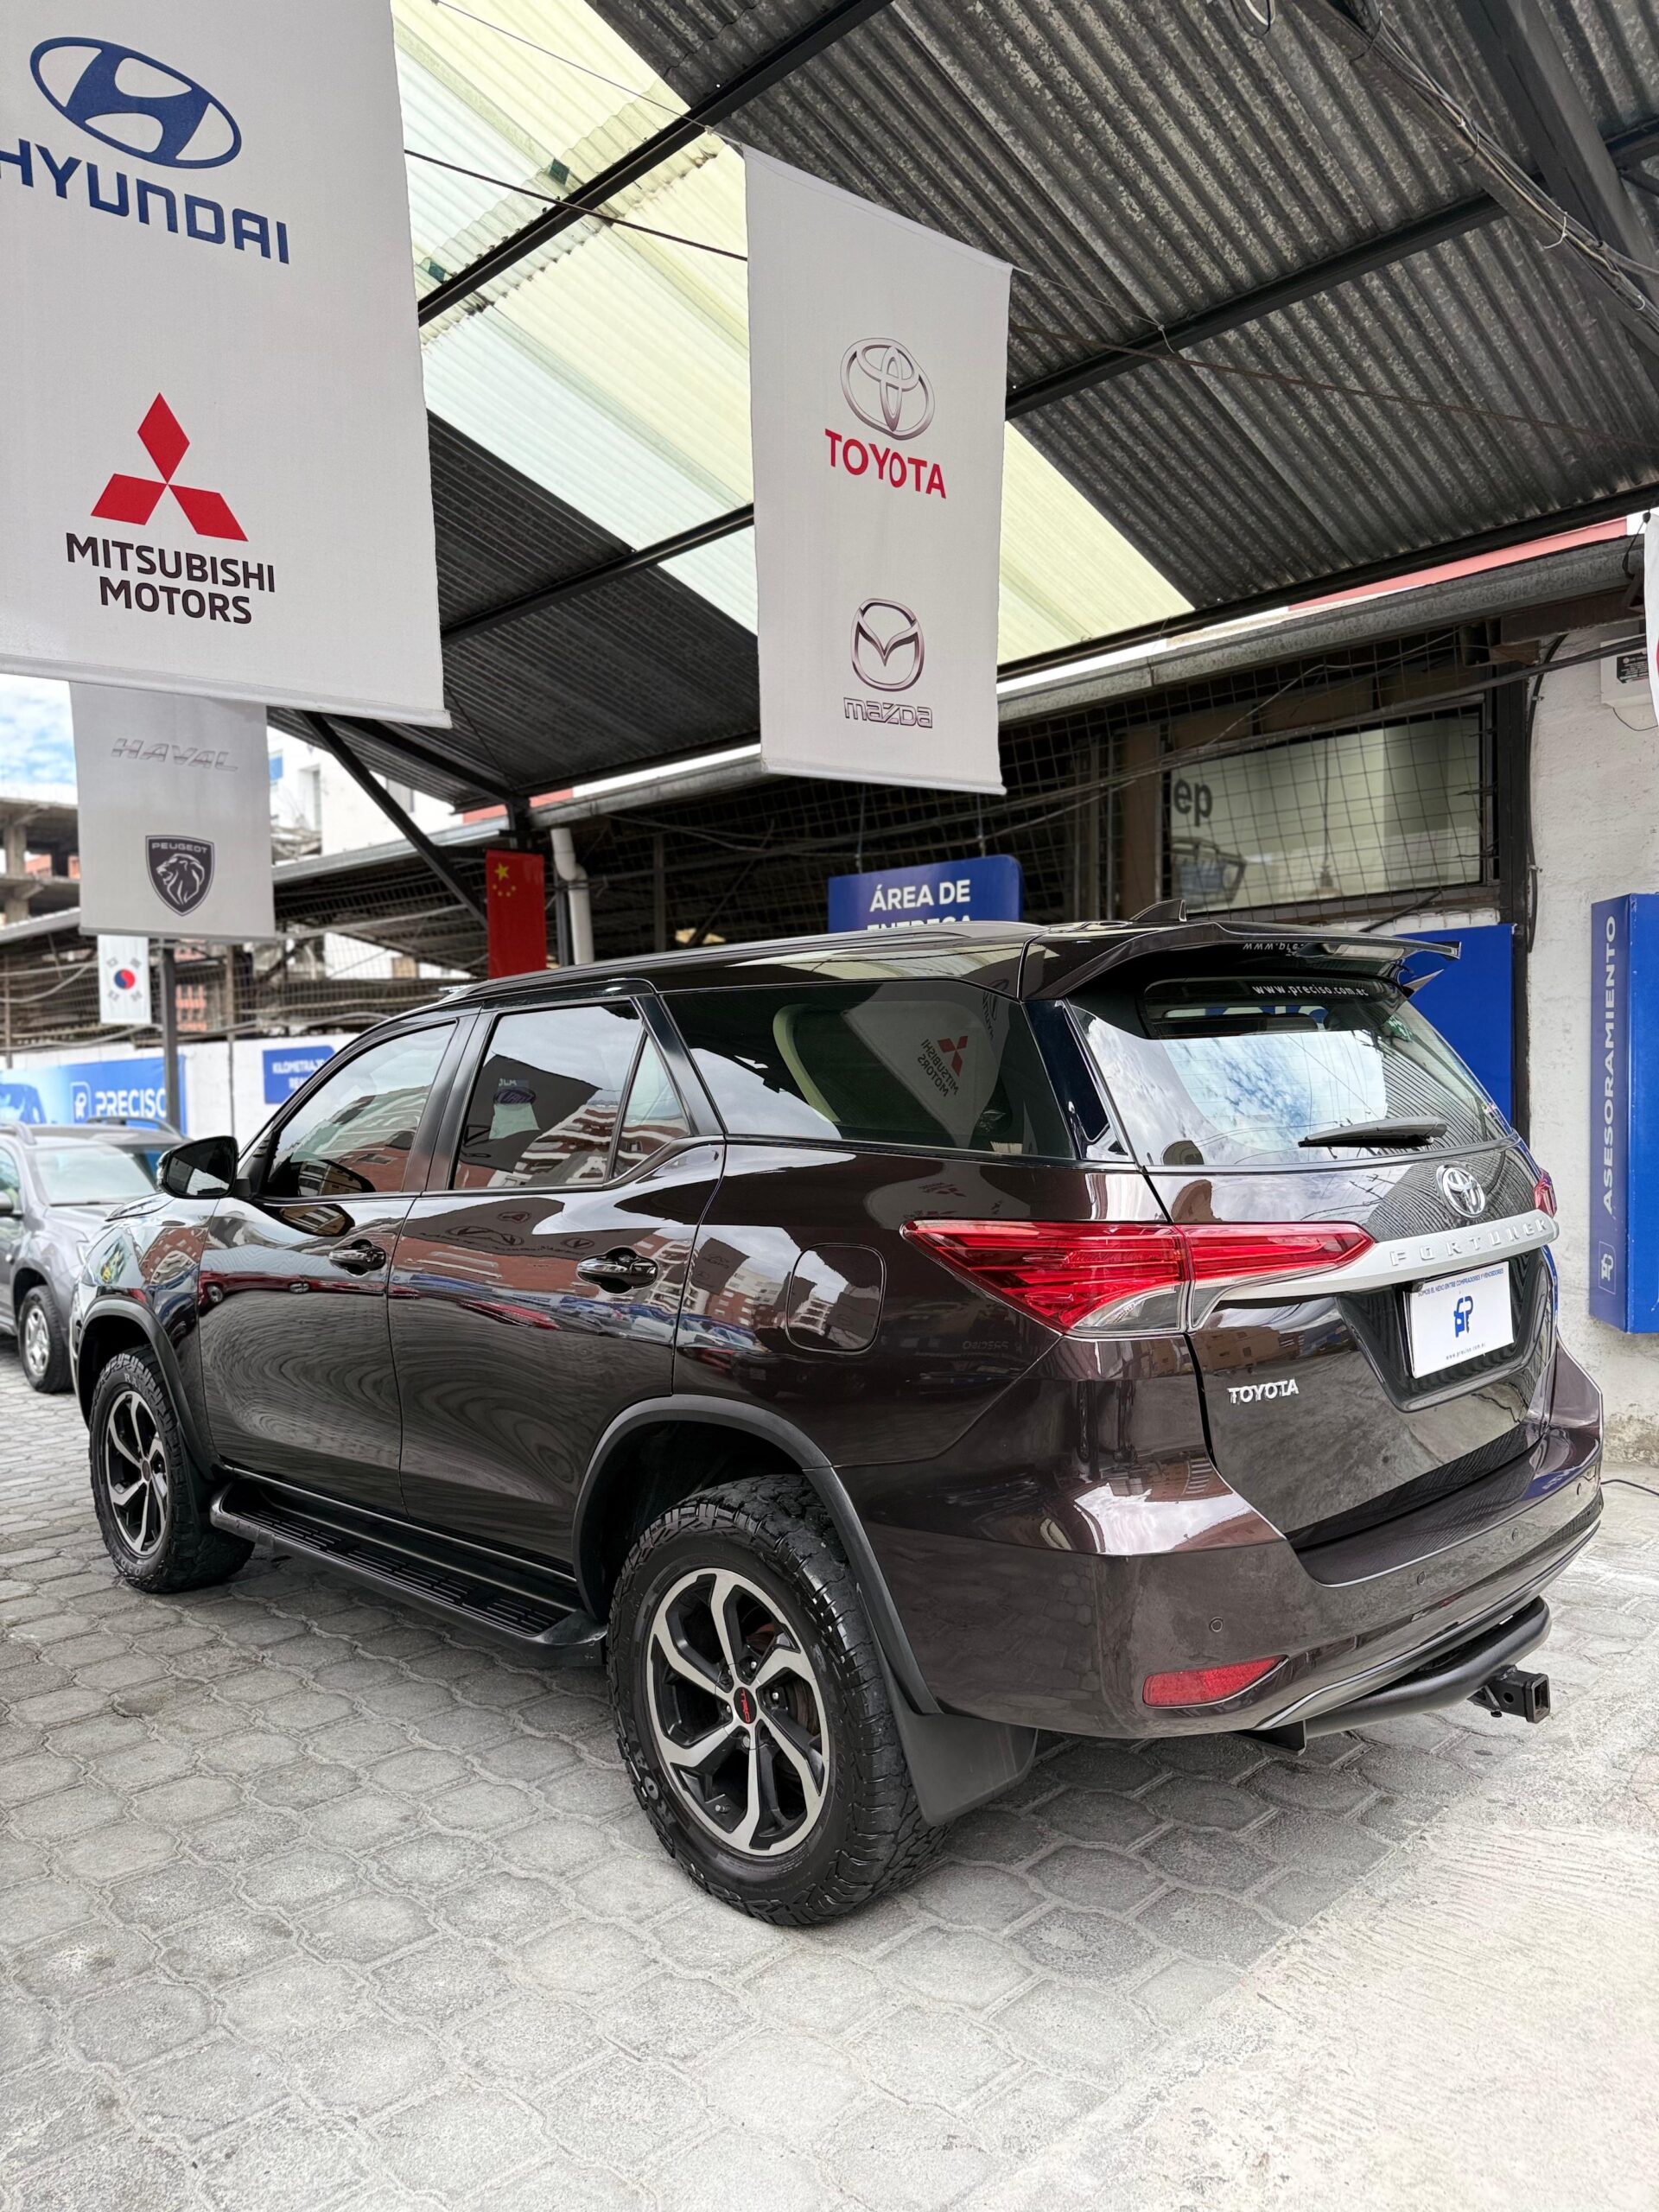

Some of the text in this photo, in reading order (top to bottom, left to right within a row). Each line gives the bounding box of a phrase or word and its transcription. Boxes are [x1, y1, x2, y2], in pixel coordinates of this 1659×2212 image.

[0, 137, 290, 265] HYUNDAI
[823, 428, 947, 499] TOYOTA
[66, 531, 276, 593] MITSUBISHI
[99, 575, 252, 625] MOTORS
[110, 737, 238, 772] HAVAL
[151, 842, 208, 854] PEUGEOT
[869, 879, 971, 912] ÁREA DE
[1252, 983, 1370, 997] www.preciso.com.ec
[1602, 914, 1617, 1216] ASESORAMIENTO
[1389, 1218, 1548, 1267] FORTUNER
[1227, 1378, 1300, 1404] TOYOTA
